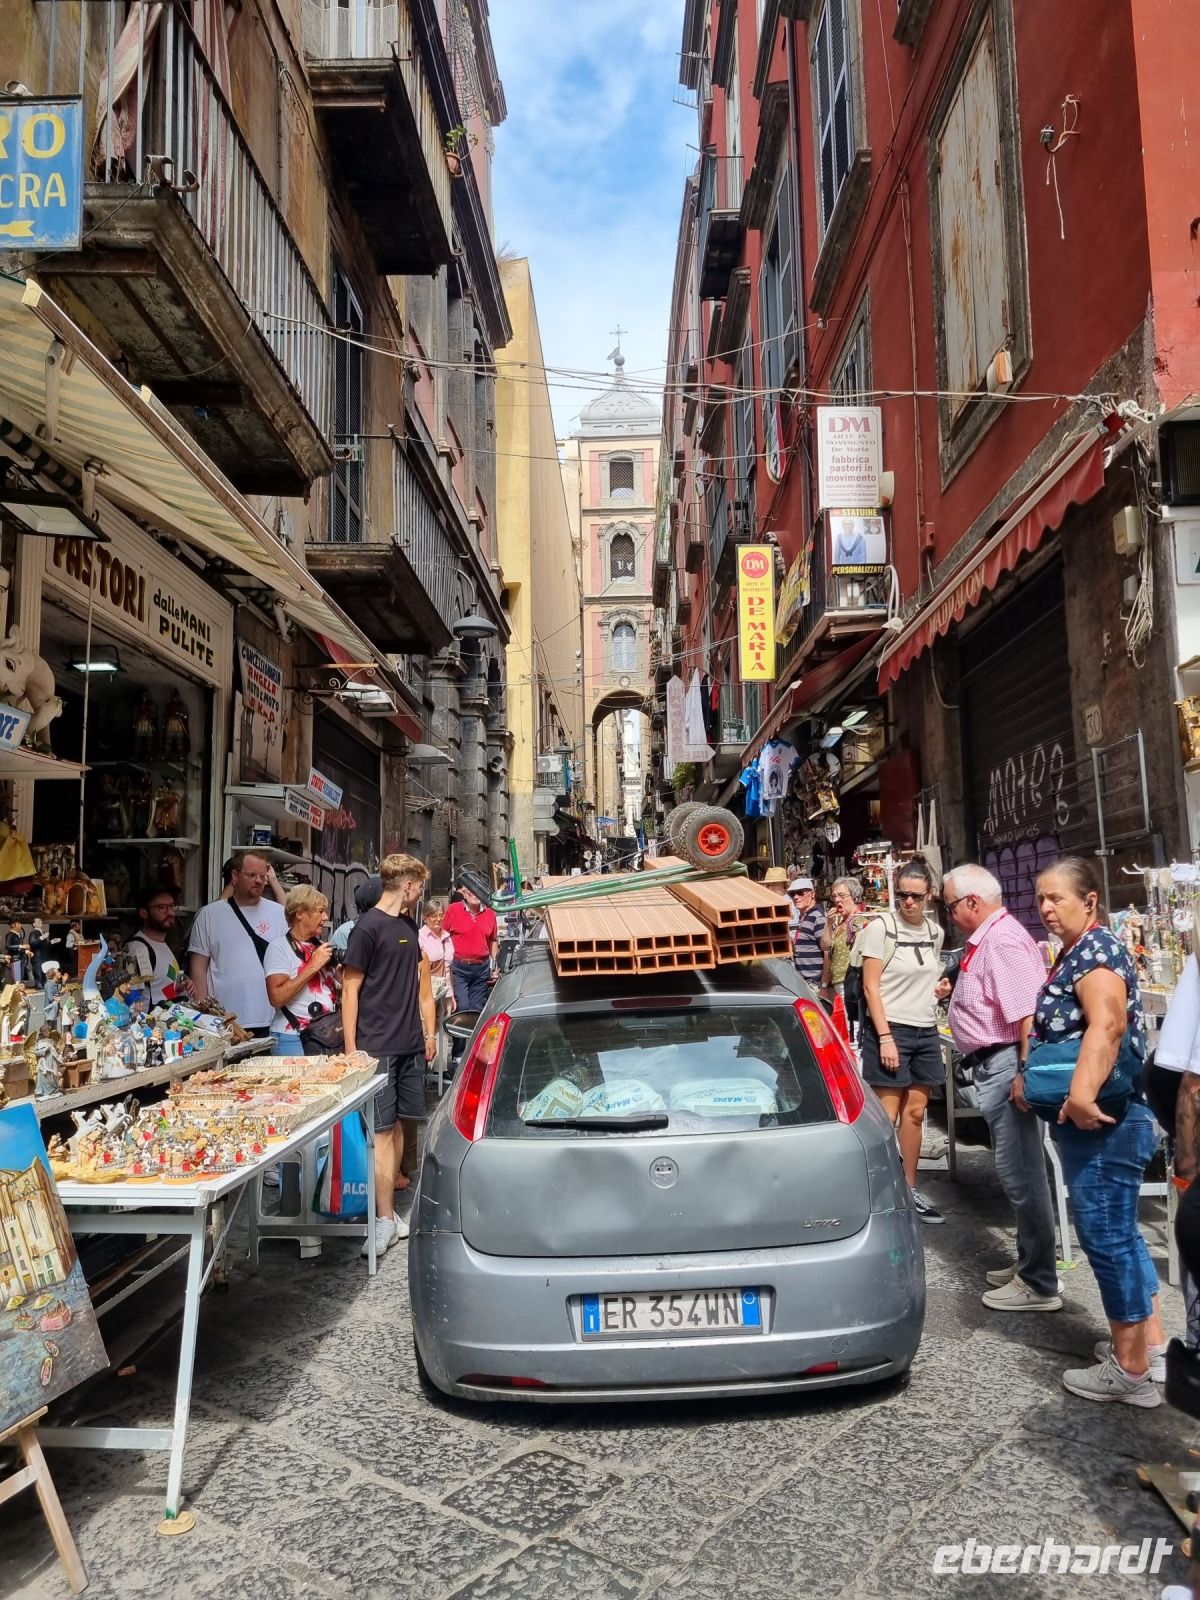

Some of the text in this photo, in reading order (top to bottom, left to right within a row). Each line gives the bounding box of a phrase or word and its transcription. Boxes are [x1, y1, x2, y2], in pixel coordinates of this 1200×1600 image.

[828, 416, 871, 433] DM
[832, 455, 870, 464] fabbrica
[830, 464, 873, 474] pastori in
[825, 473, 877, 482] movimento
[841, 508, 878, 516] STATUINE
[745, 559, 765, 570] DM
[832, 564, 884, 575] PERSONALIZZATE
[52, 536, 146, 623] PASTORI
[153, 588, 211, 643] dalle MANI
[159, 615, 214, 668] PULITE
[747, 621, 767, 672] MARIA
[1086, 710, 1101, 738] 30
[342, 1182, 369, 1196] ALC
[603, 1296, 638, 1329] ER
[649, 1292, 740, 1328] 354WN
